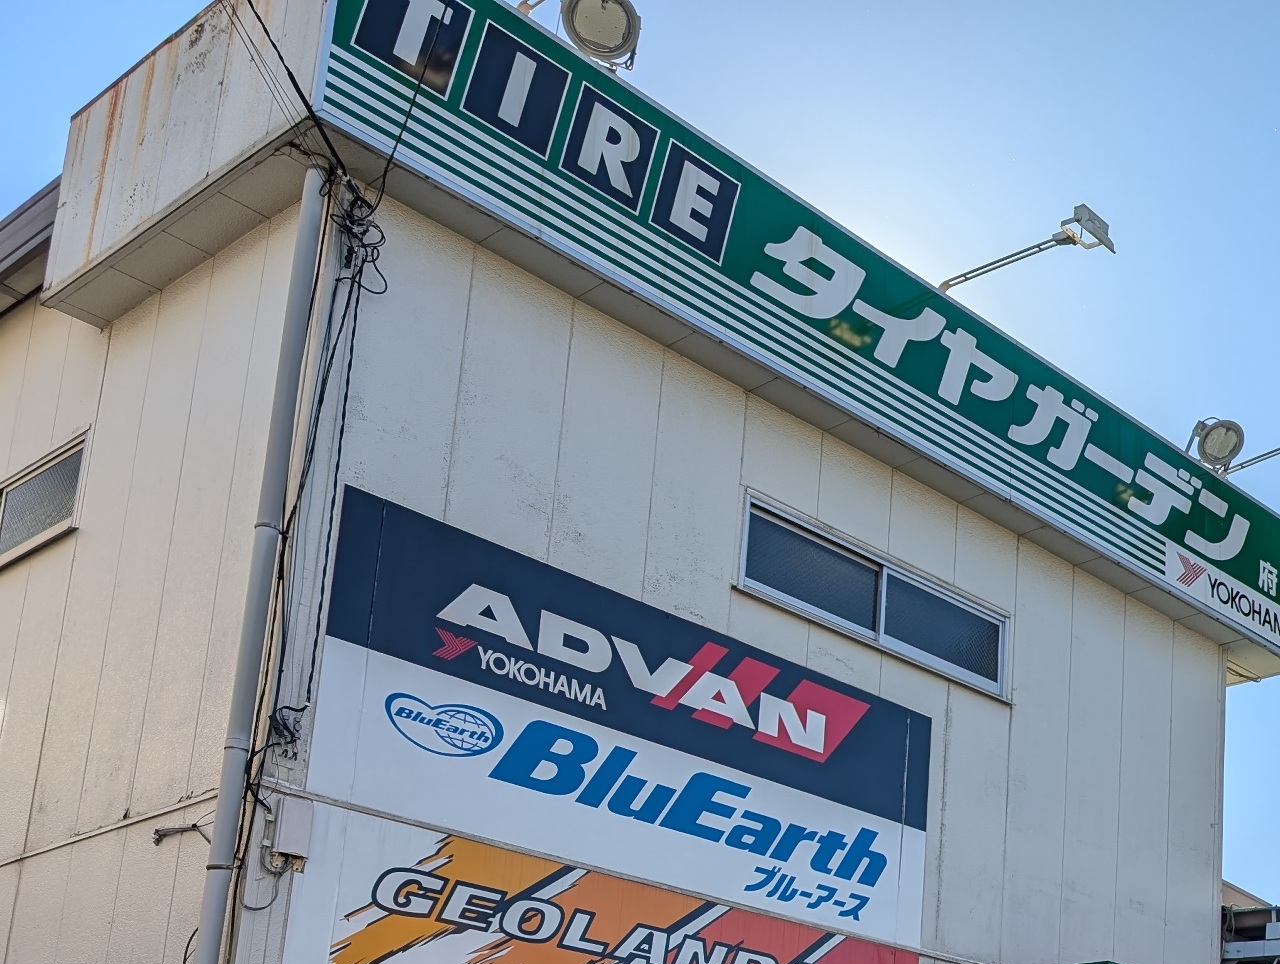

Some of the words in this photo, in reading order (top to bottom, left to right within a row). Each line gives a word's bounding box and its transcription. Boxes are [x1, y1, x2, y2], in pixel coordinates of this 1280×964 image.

[393, 0, 722, 243] TIRE
[750, 226, 1250, 561] タイヤガーデン
[394, 704, 492, 747] BluEarth
[435, 582, 828, 754] ADVAN
[477, 646, 607, 711] YOKOHAMA
[488, 718, 889, 888] BluEarth
[743, 865, 870, 921] ブルーアース
